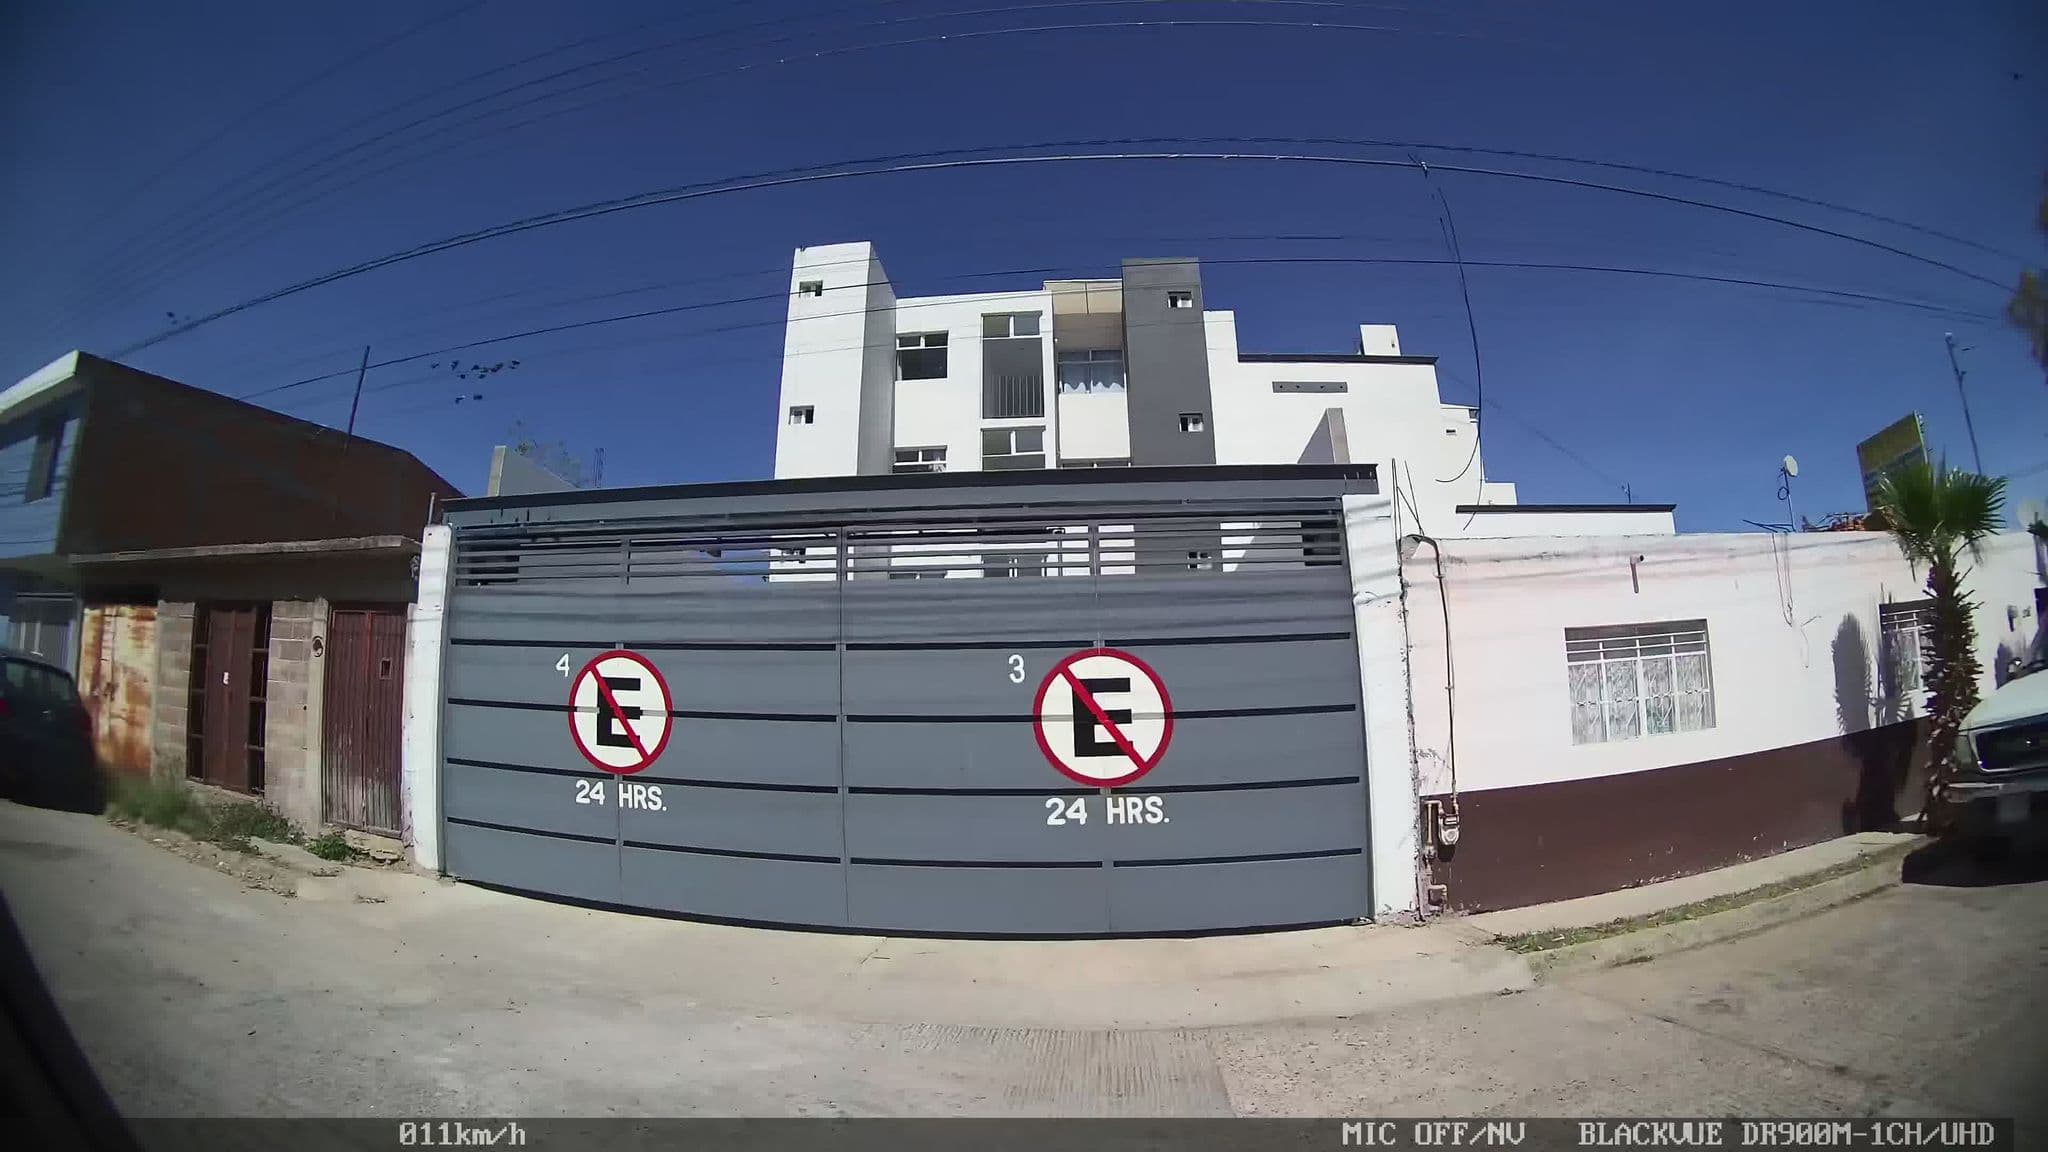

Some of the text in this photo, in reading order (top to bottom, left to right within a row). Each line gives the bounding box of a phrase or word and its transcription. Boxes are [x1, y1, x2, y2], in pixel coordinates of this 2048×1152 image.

[555, 652, 571, 678] 4
[1008, 653, 1026, 684] 3
[596, 676, 641, 749] E
[1072, 677, 1134, 757] E
[575, 779, 667, 812] 24 HRS.
[1045, 796, 1170, 826] 24 HRS.
